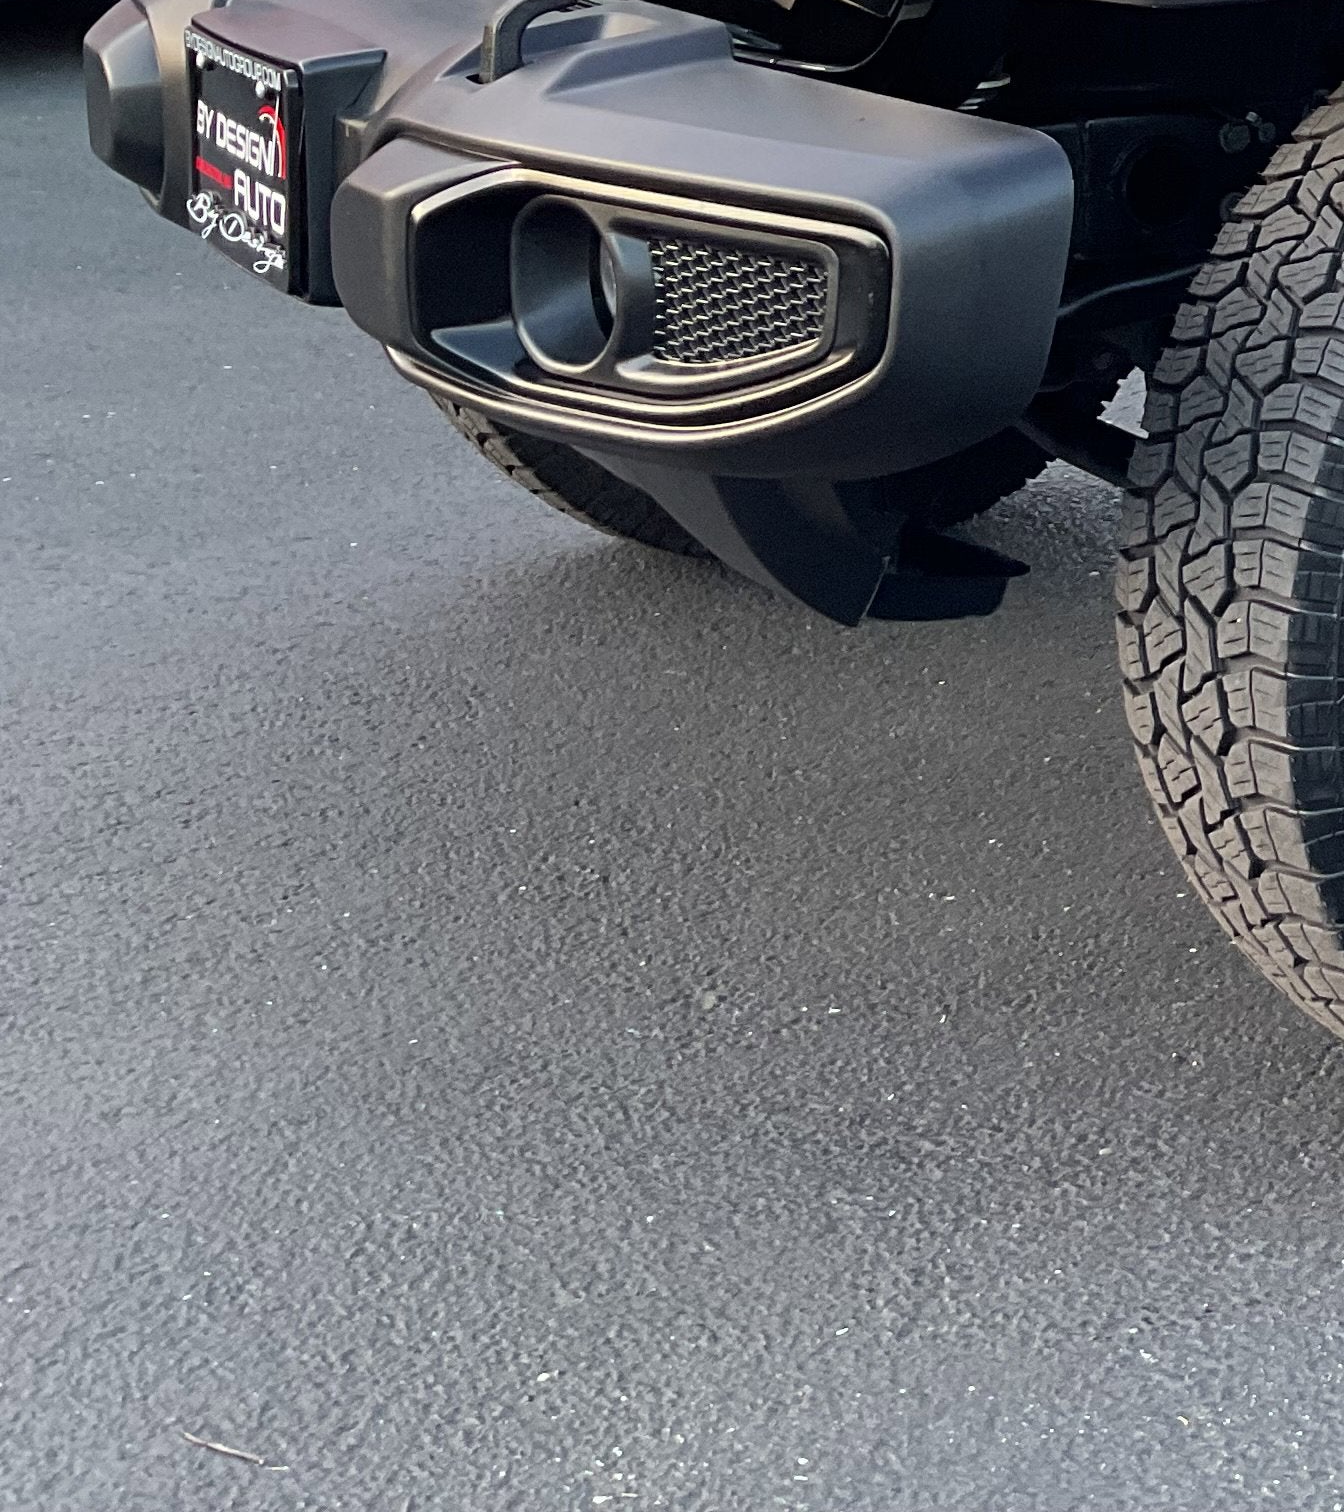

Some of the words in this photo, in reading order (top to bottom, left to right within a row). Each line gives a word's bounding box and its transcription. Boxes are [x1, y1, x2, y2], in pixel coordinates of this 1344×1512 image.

[196, 99, 215, 139] BY
[215, 112, 275, 177] DESIGN
[234, 168, 286, 236] AUTO
